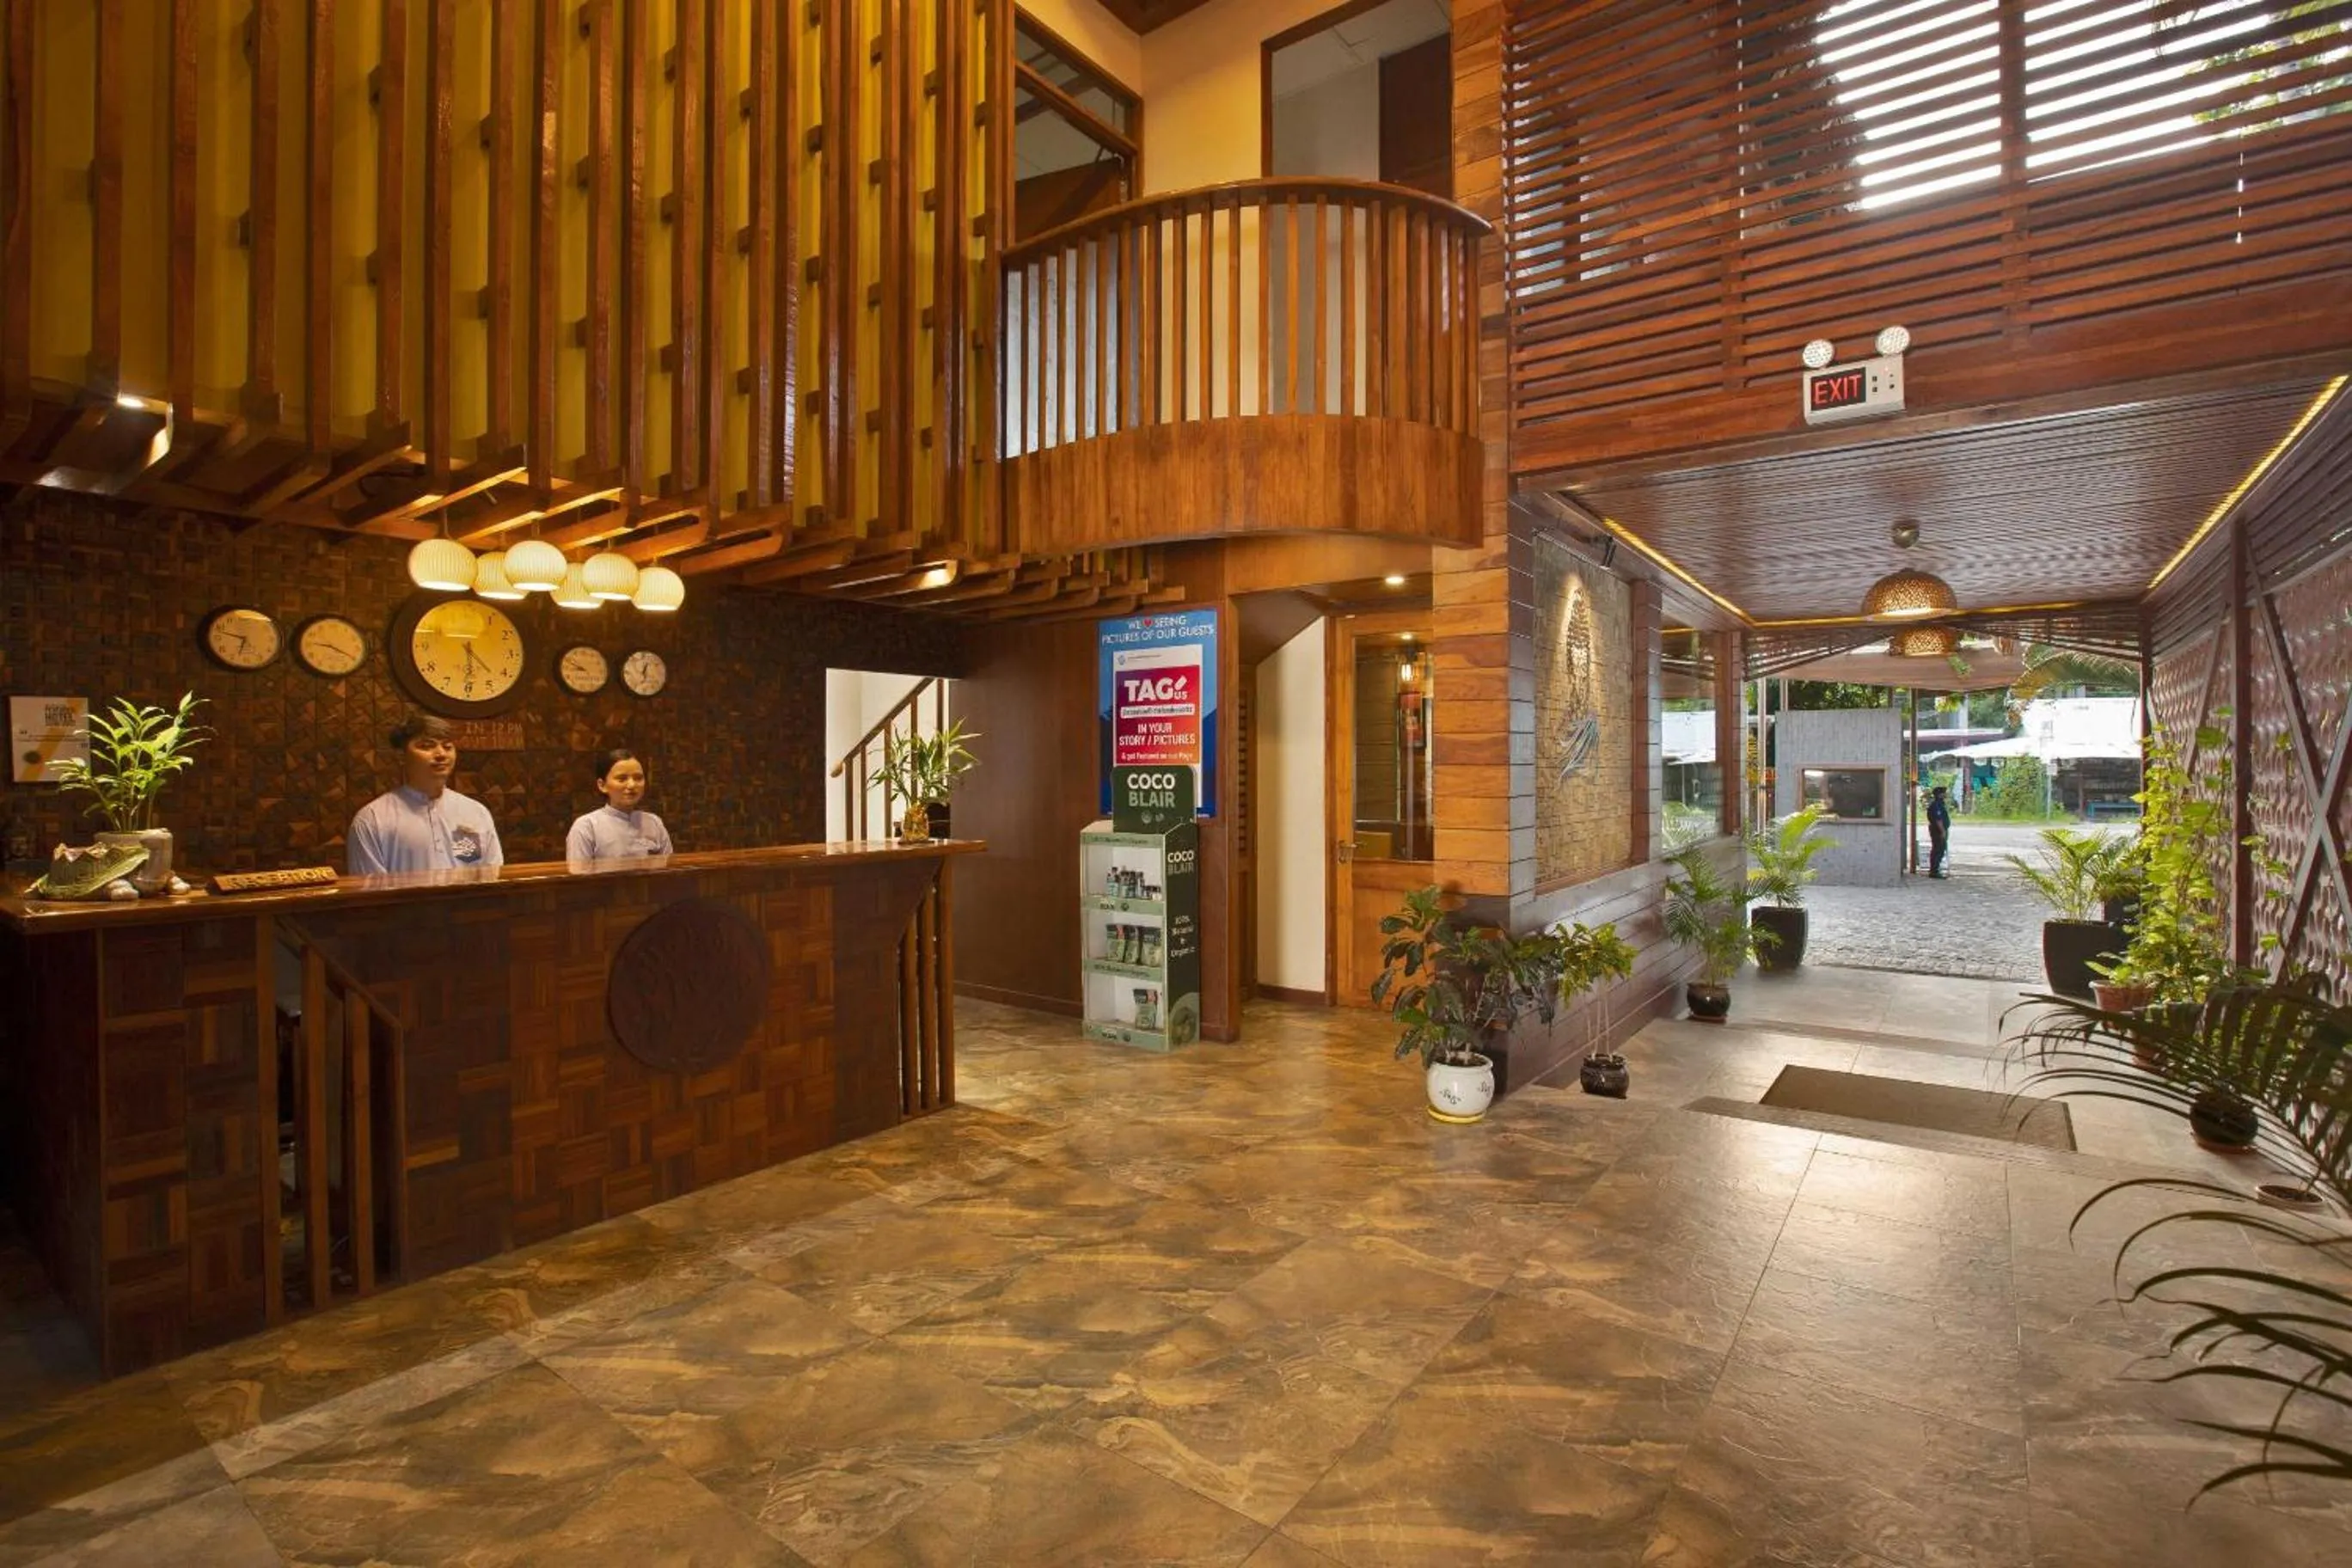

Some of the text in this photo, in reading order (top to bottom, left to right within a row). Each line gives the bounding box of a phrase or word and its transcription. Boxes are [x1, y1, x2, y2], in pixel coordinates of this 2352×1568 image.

[1815, 374, 1862, 405] EXIT
[1155, 616, 1186, 628] SEEING
[1101, 624, 1214, 646] PICTURES OF OUR GUESTS
[1124, 677, 1174, 702] TAG
[1138, 722, 1173, 733] IN YOUR
[1119, 735, 1146, 746] STORY
[1153, 733, 1196, 746] PICTURES
[1127, 774, 1175, 790] COCO
[1128, 791, 1176, 808] BLAIR
[1168, 850, 1194, 863] COCO
[227, 867, 329, 889] RECEPTION
